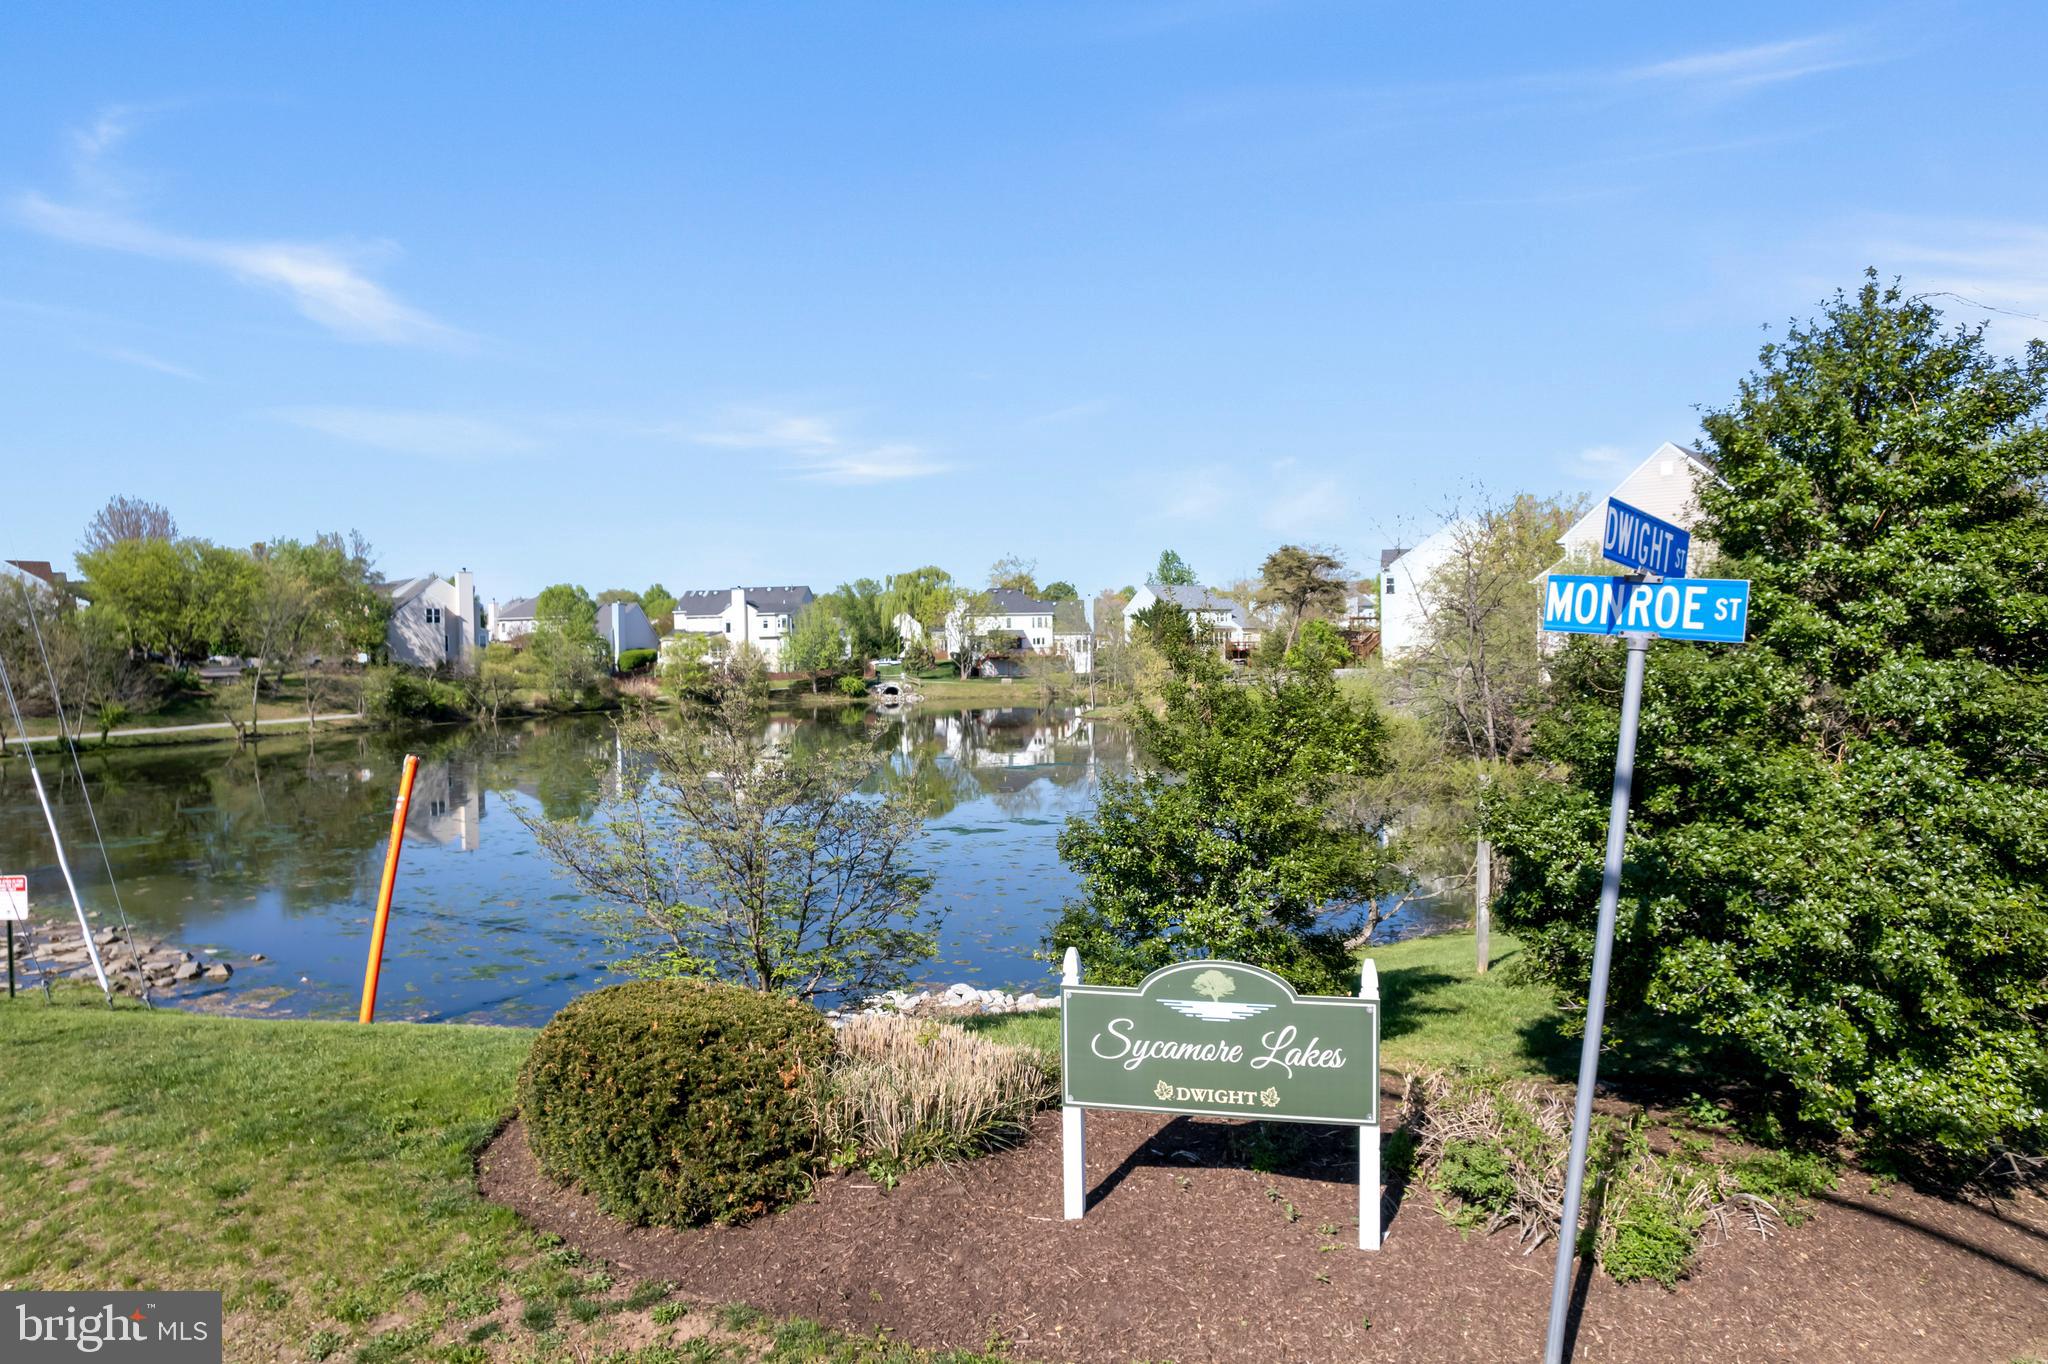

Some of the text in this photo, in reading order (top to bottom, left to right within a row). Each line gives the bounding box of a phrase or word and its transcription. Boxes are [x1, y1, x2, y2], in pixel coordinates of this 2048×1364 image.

[1605, 506, 1686, 573] DWIGHT ST
[1546, 581, 1742, 630] MONROE ST
[1091, 1018, 1346, 1079] Sycamore Lakes
[1176, 1087, 1257, 1105] DWIGHT
